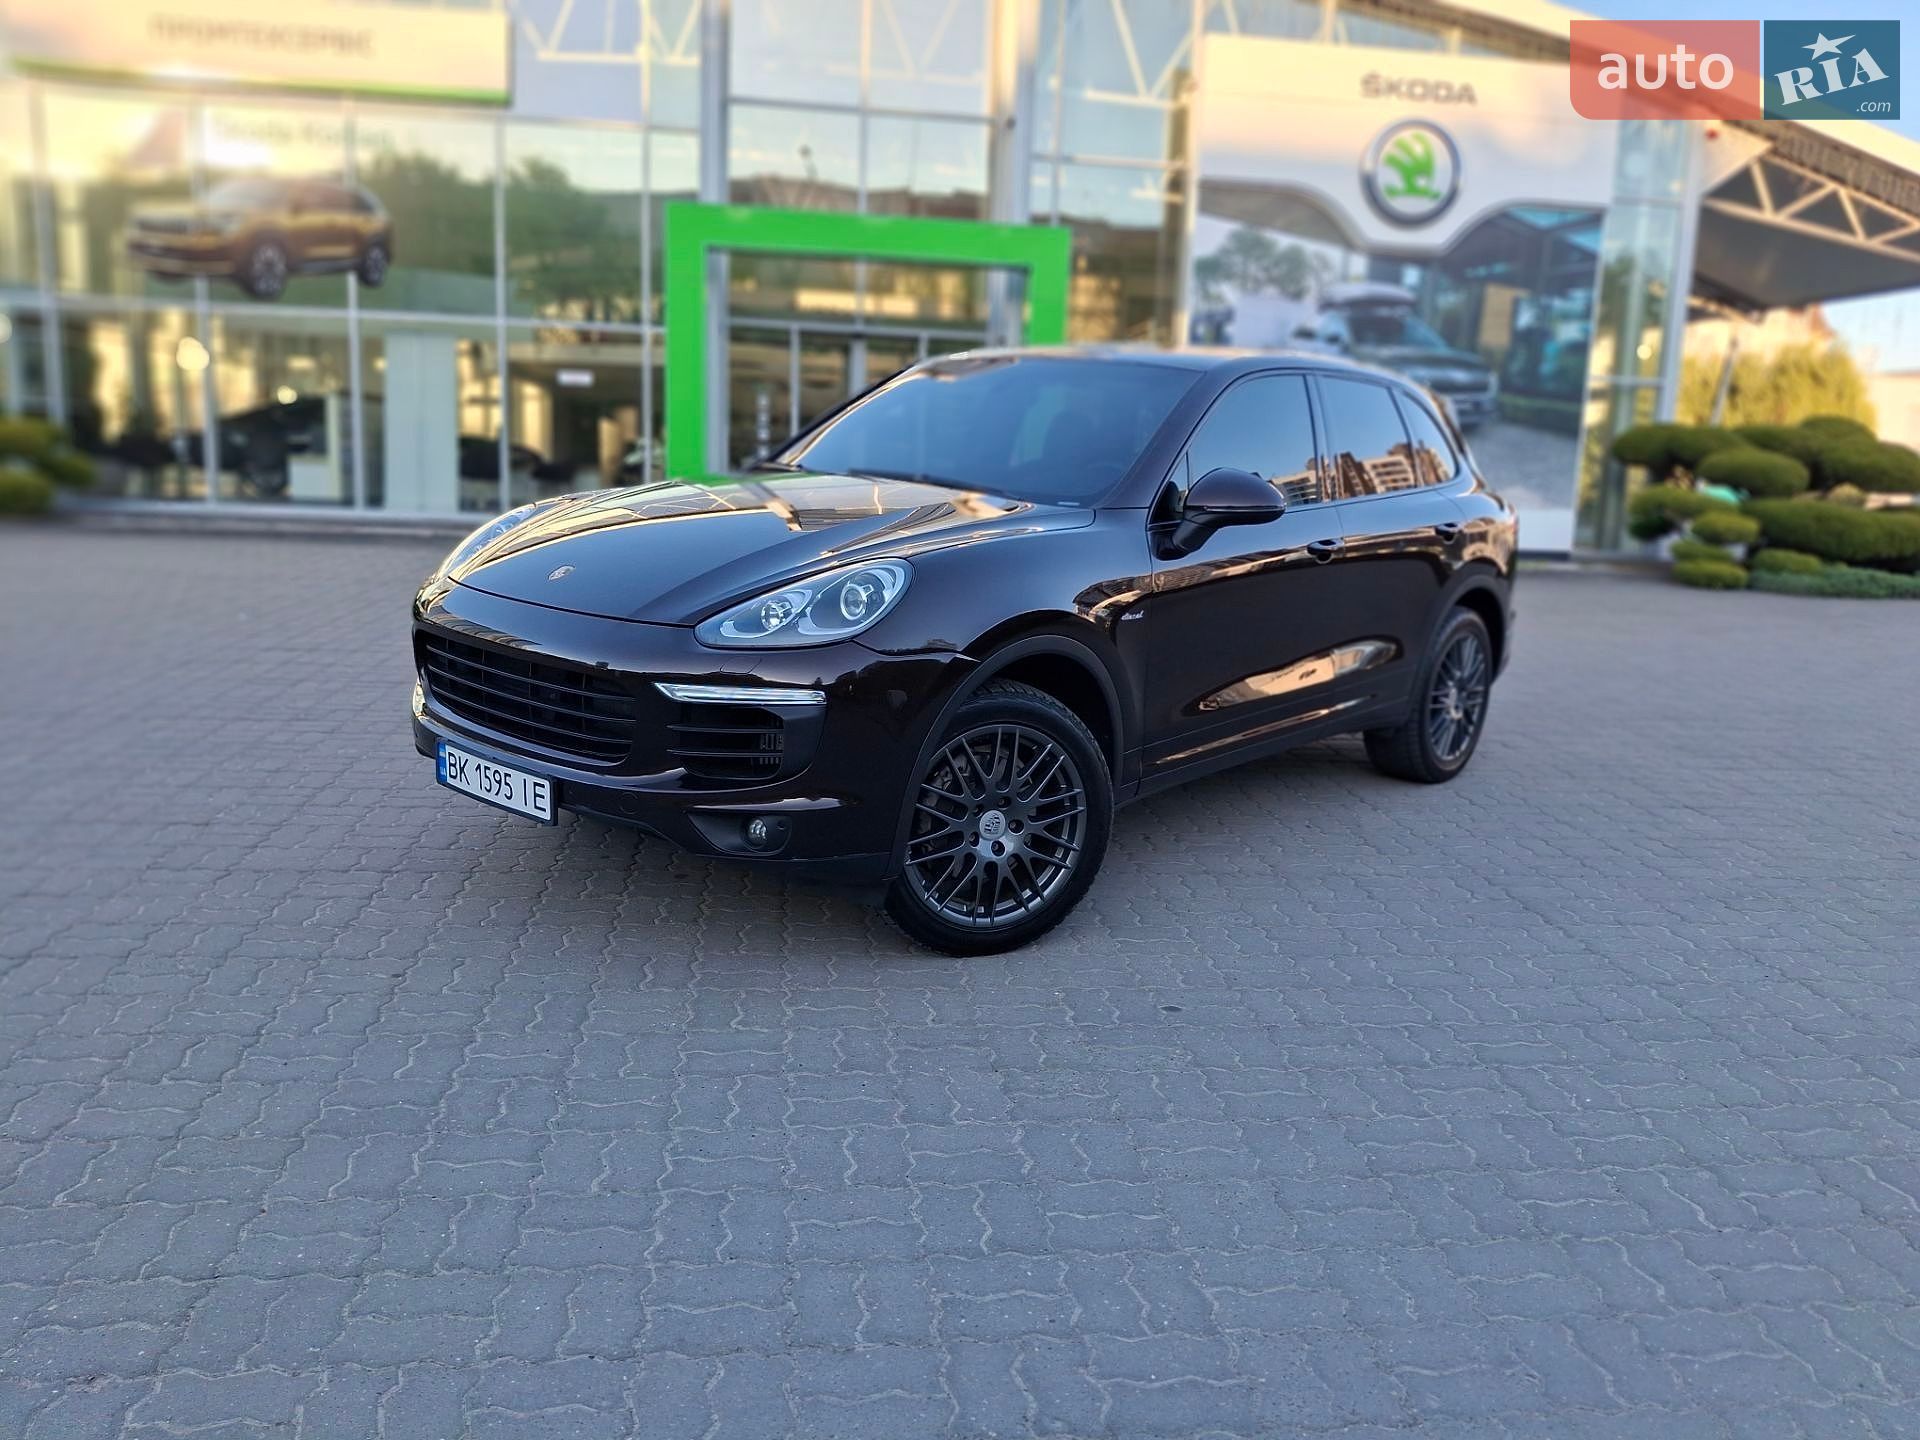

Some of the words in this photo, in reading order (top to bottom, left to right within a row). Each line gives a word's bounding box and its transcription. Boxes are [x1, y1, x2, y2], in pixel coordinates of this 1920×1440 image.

[447, 751, 470, 786] BK
[475, 763, 514, 800] 1595
[523, 778, 547, 813] IE
